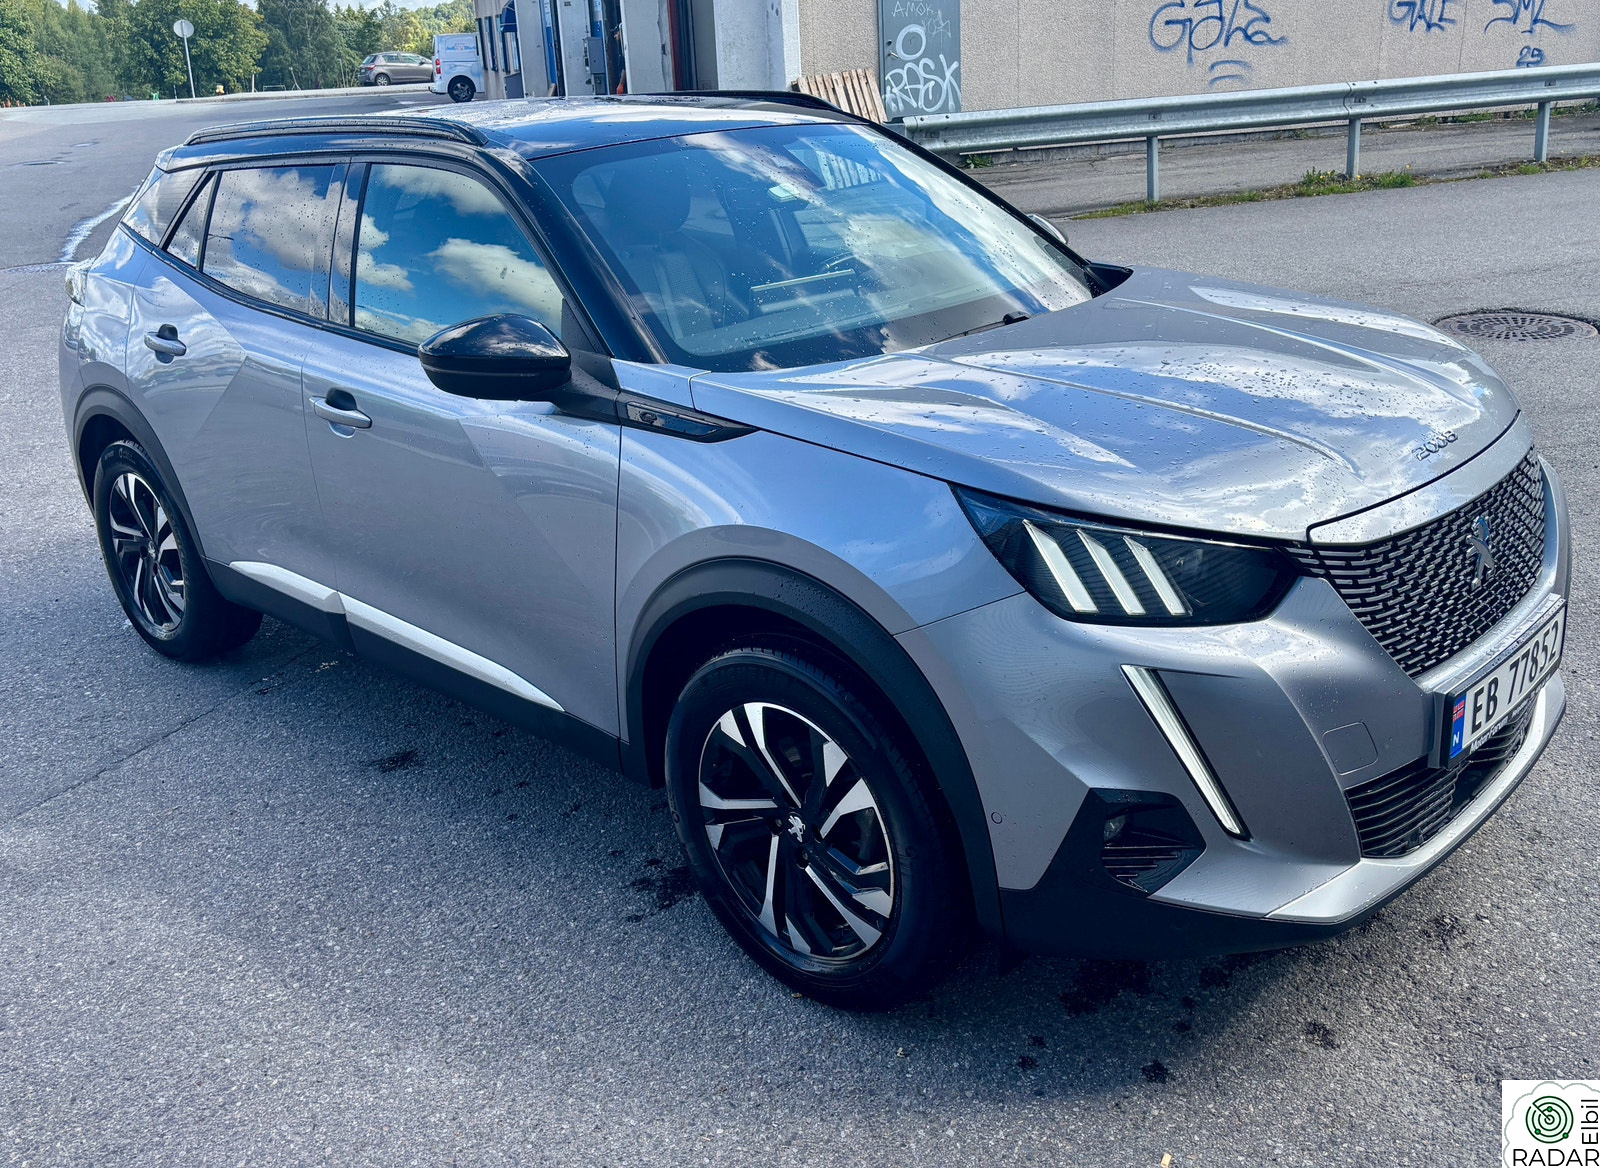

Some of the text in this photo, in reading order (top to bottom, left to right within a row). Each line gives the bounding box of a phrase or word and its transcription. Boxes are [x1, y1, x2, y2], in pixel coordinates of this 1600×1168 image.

[1411, 430, 1458, 461] 2008
[1471, 619, 1559, 735] EB 77852
[1453, 732, 1460, 747] N
